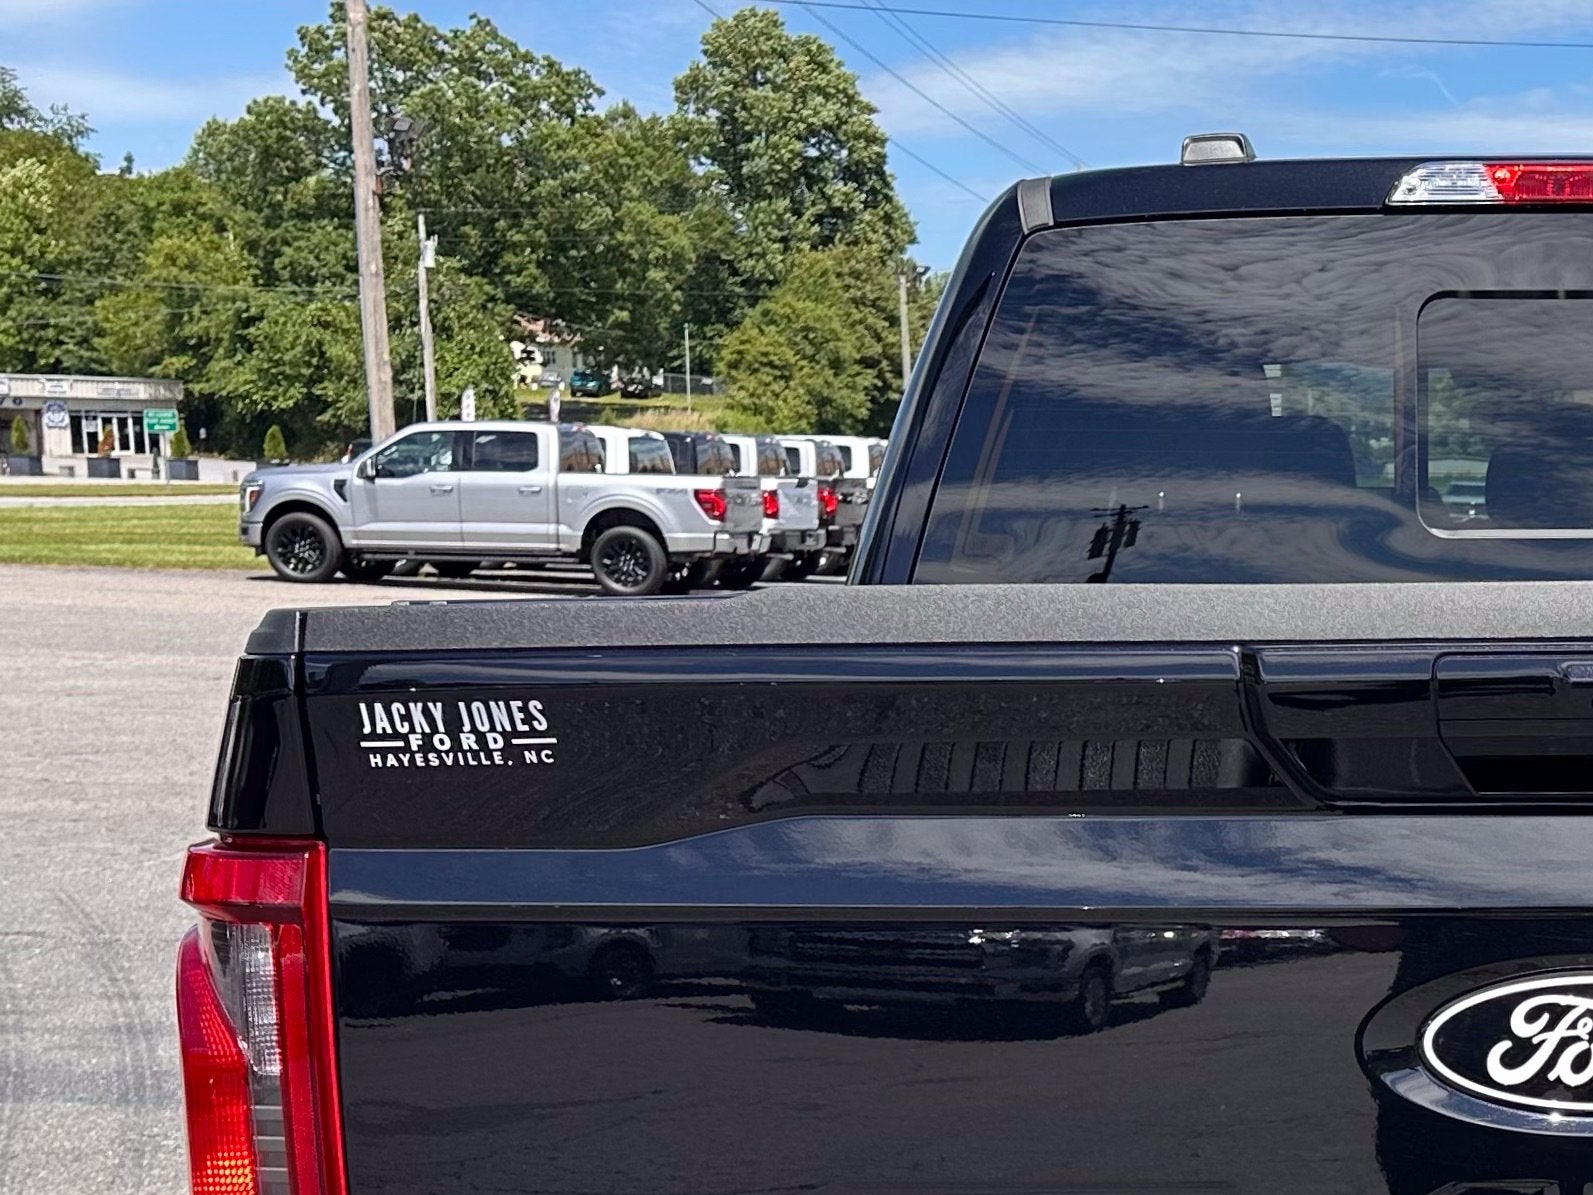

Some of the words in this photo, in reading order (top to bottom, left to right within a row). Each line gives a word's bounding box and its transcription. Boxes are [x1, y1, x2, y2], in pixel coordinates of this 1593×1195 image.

[358, 702, 446, 734] JACKY
[457, 700, 548, 732] JONES
[408, 732, 504, 751] FORD
[369, 752, 513, 767] HAYESVILLE,
[524, 750, 555, 764] NC
